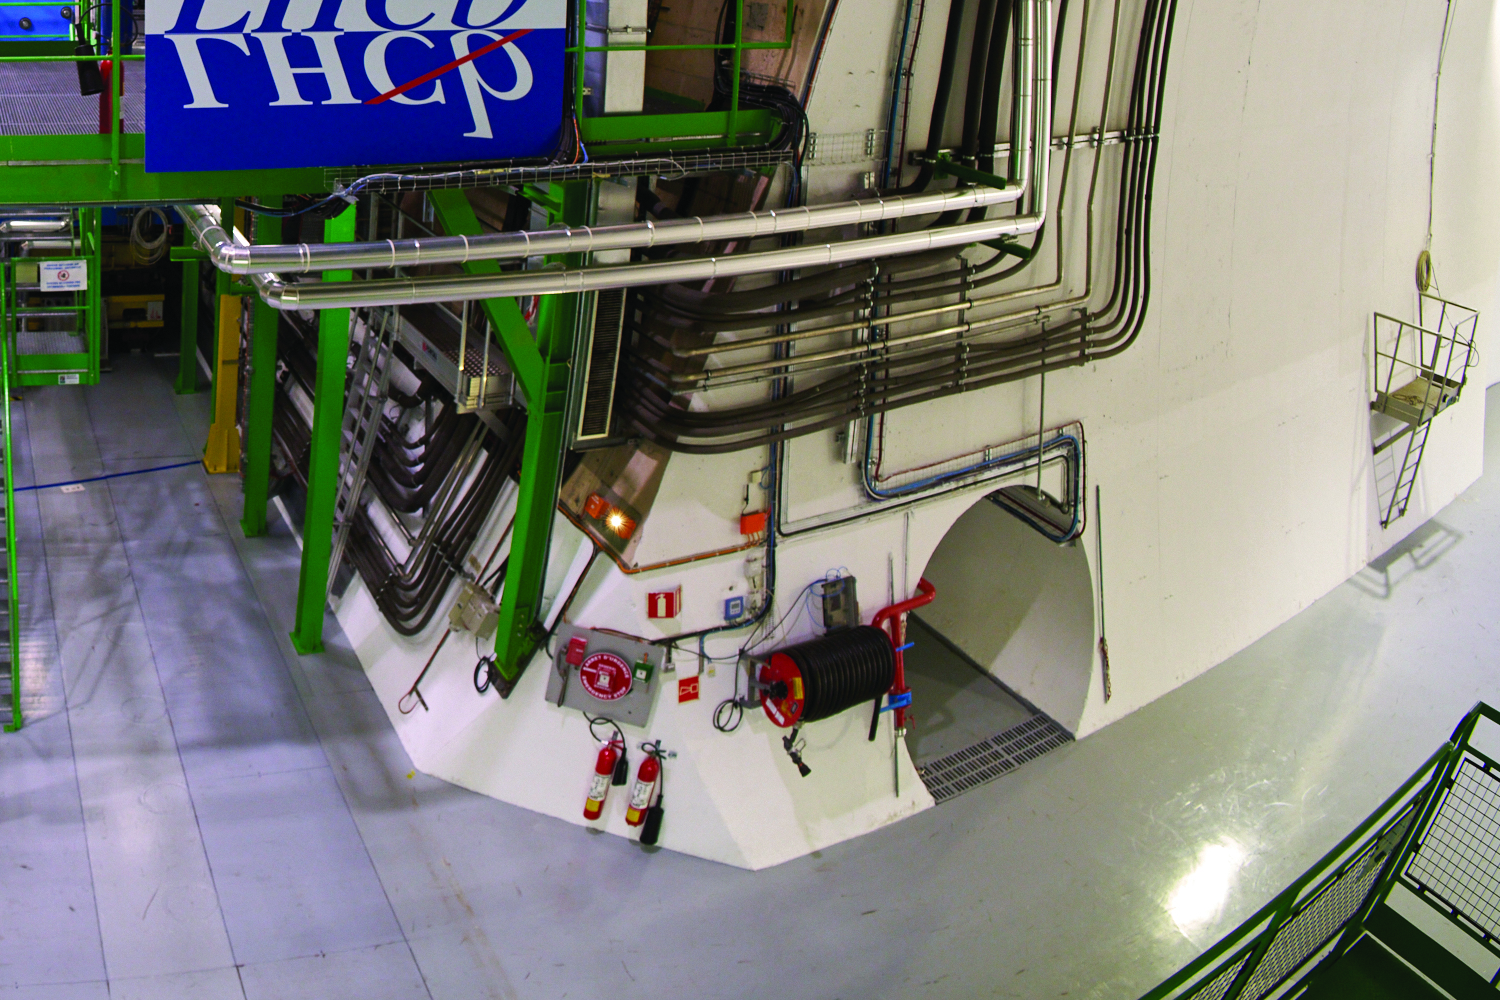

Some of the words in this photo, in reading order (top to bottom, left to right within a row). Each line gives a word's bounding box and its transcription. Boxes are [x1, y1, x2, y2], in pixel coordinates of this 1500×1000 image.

[603, 655, 630, 679] D'URGENCE
[582, 675, 612, 699] EMERGENCY
[613, 686, 626, 698] STOP
